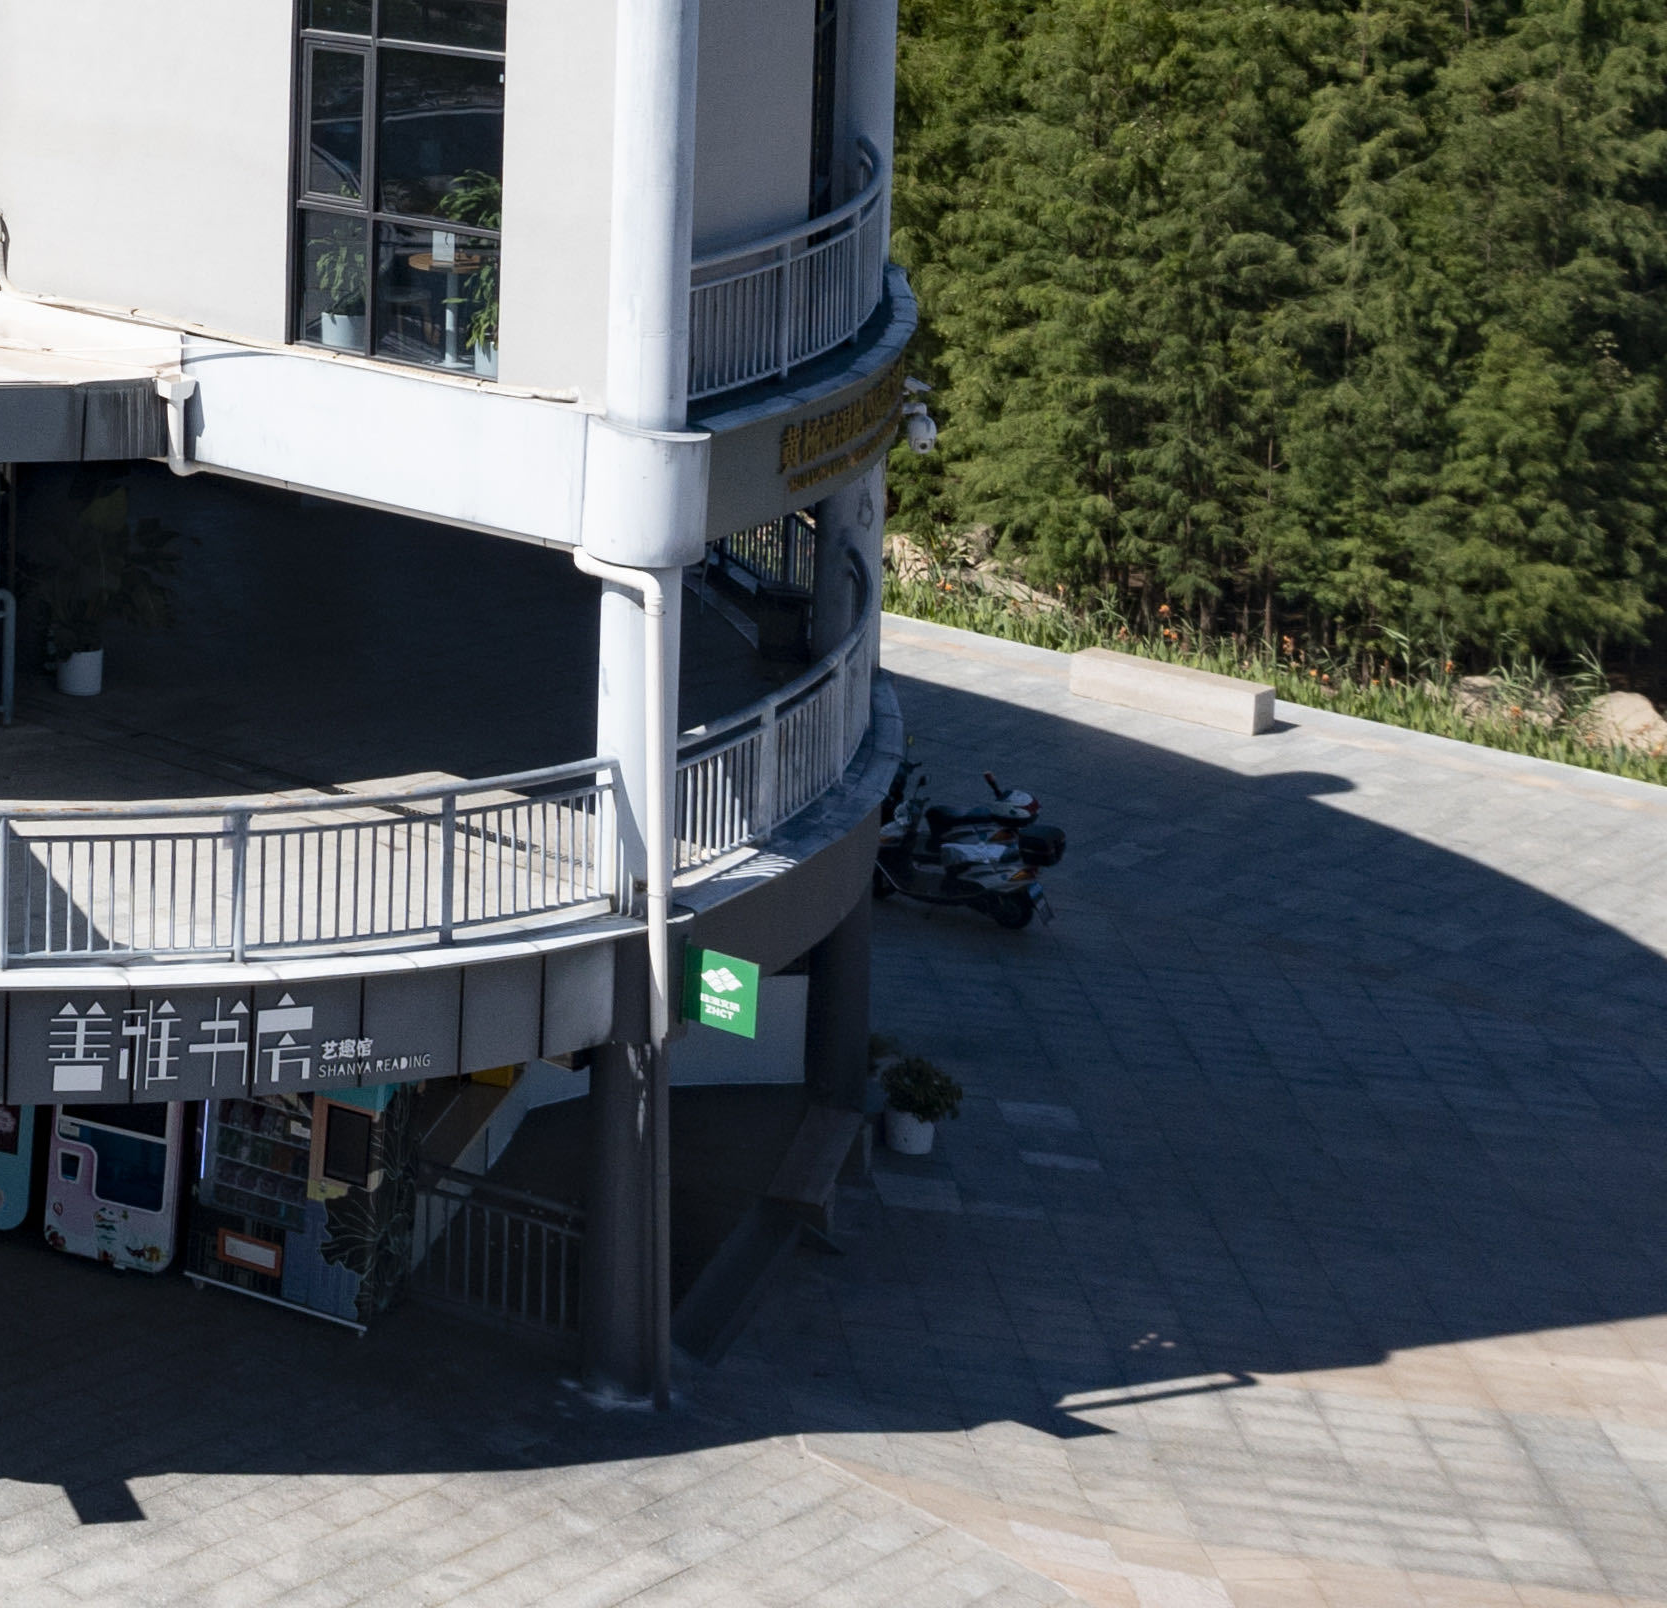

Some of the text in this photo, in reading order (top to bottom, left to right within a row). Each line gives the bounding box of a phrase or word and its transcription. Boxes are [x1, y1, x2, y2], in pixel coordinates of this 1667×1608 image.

[705, 1004, 734, 1020] ZHCT
[48, 993, 314, 1091] 善雅书房
[320, 1038, 373, 1060] 艺趣馆
[318, 1054, 431, 1079] SHANYA READING
